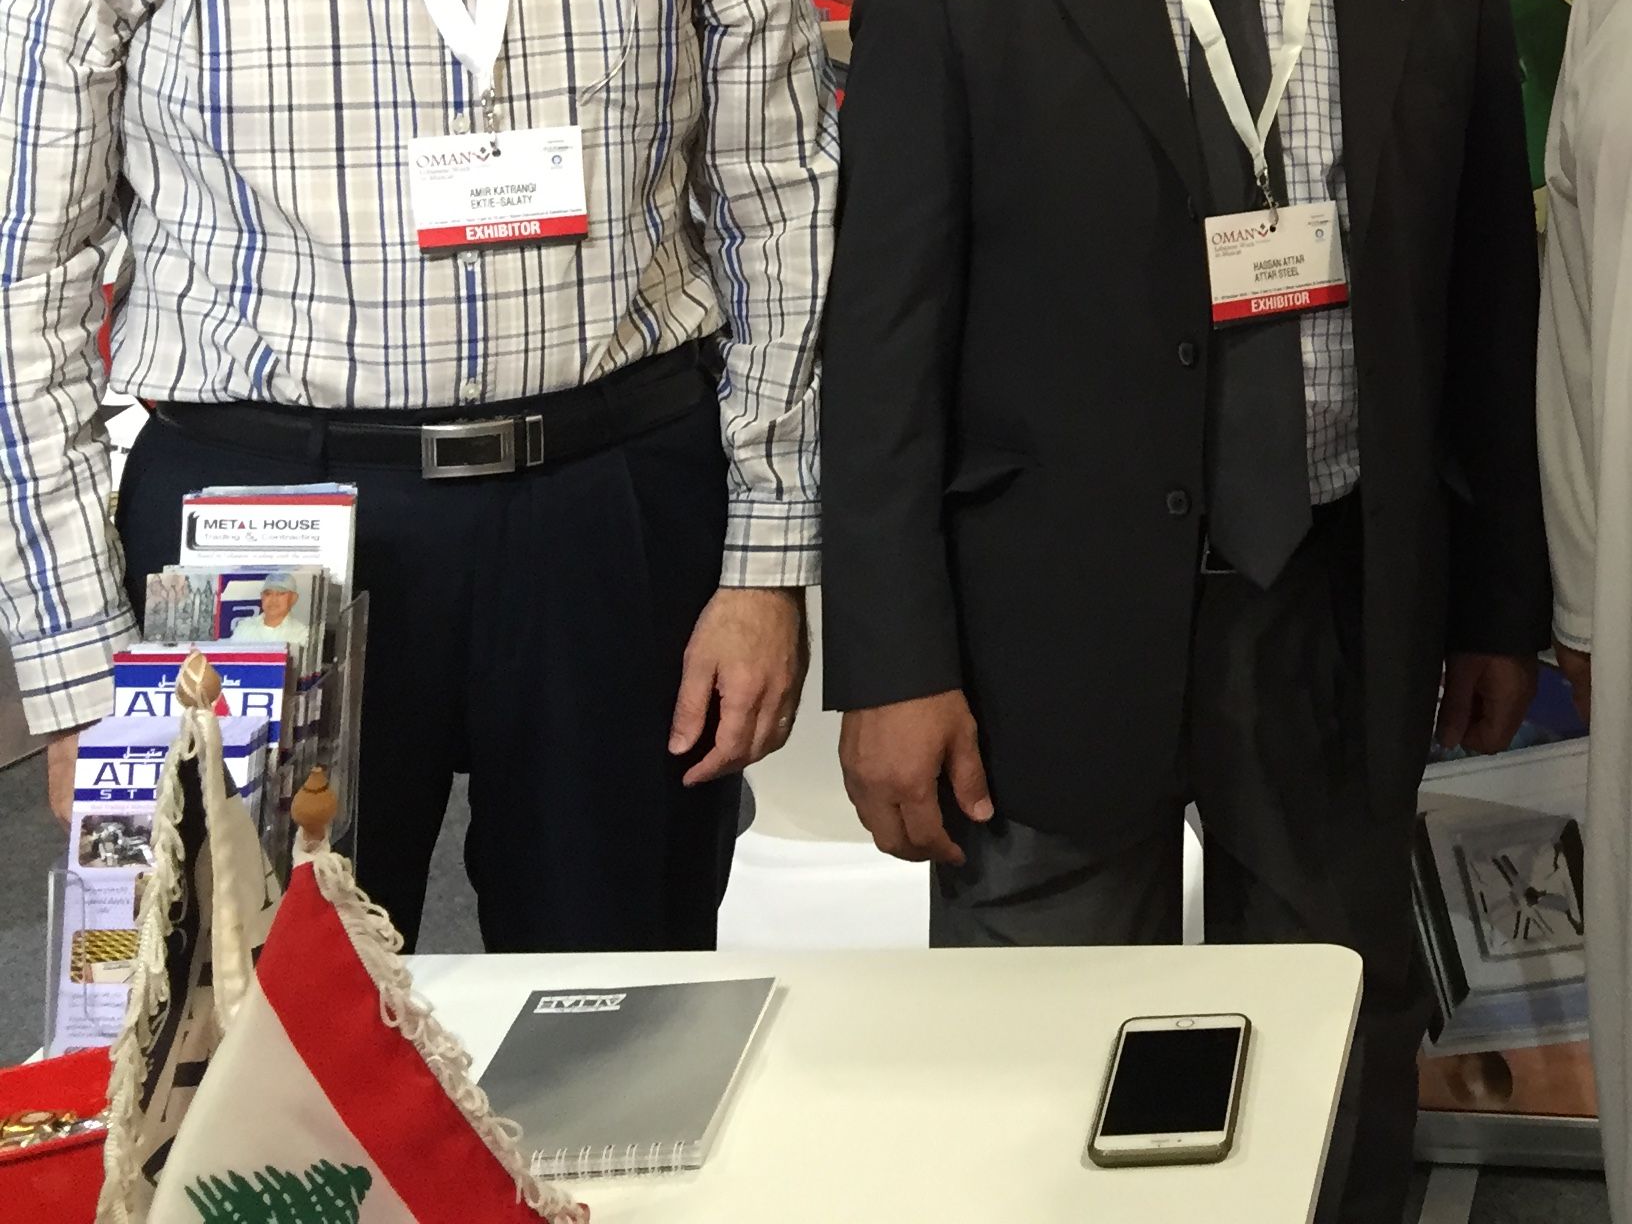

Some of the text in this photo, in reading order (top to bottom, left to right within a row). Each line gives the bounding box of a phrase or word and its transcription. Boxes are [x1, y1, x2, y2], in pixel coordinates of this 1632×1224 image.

[415, 151, 473, 169] OMAN
[465, 221, 541, 241] EXHIBITOR
[1211, 228, 1255, 245] OMAN
[1251, 291, 1311, 313] EXHIBITOR
[203, 519, 321, 530] METAL HOUSE
[93, 762, 165, 786] ATT
